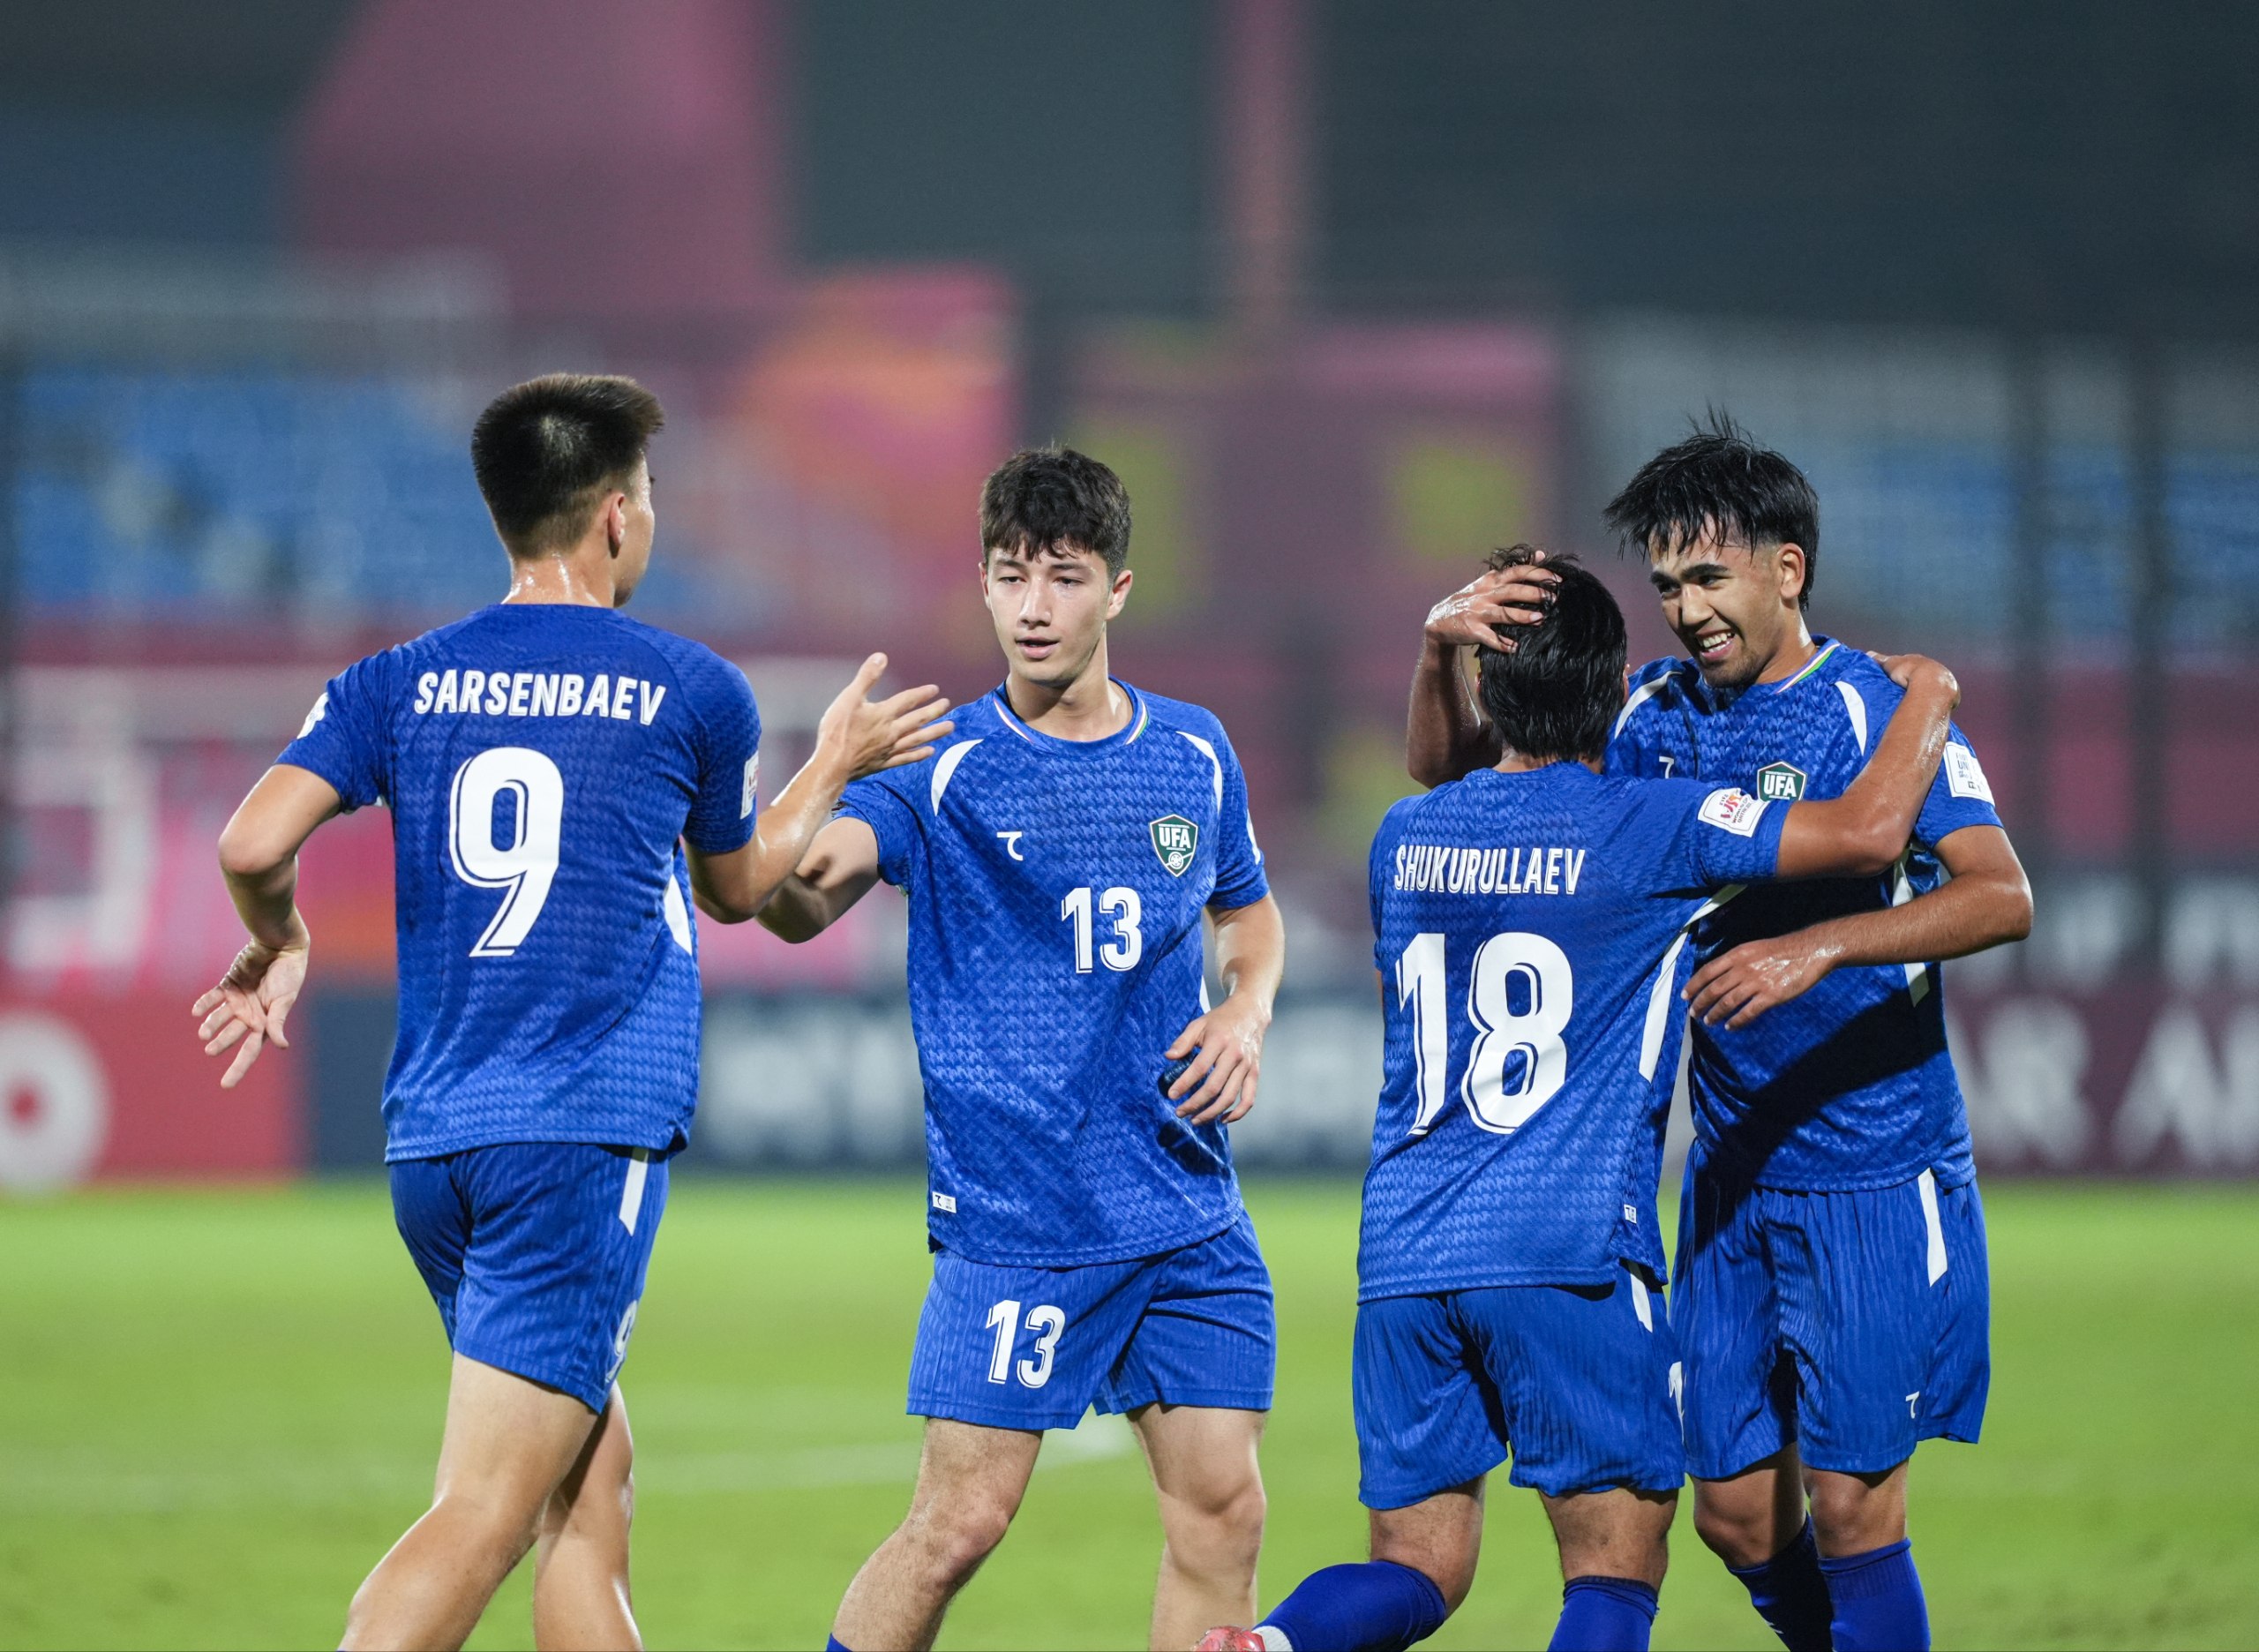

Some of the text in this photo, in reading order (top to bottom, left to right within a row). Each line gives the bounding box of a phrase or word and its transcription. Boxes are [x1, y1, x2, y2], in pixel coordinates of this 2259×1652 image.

[414, 669, 666, 726] SARSENBAEV
[1763, 774, 1797, 798] UFA
[449, 747, 565, 957] 9
[1158, 826, 1192, 849] UFA
[1394, 844, 1586, 895] SHUKURULLAEV
[1061, 886, 1143, 974] 13
[1395, 931, 1573, 1137] 18
[985, 1299, 1066, 1389] 13
